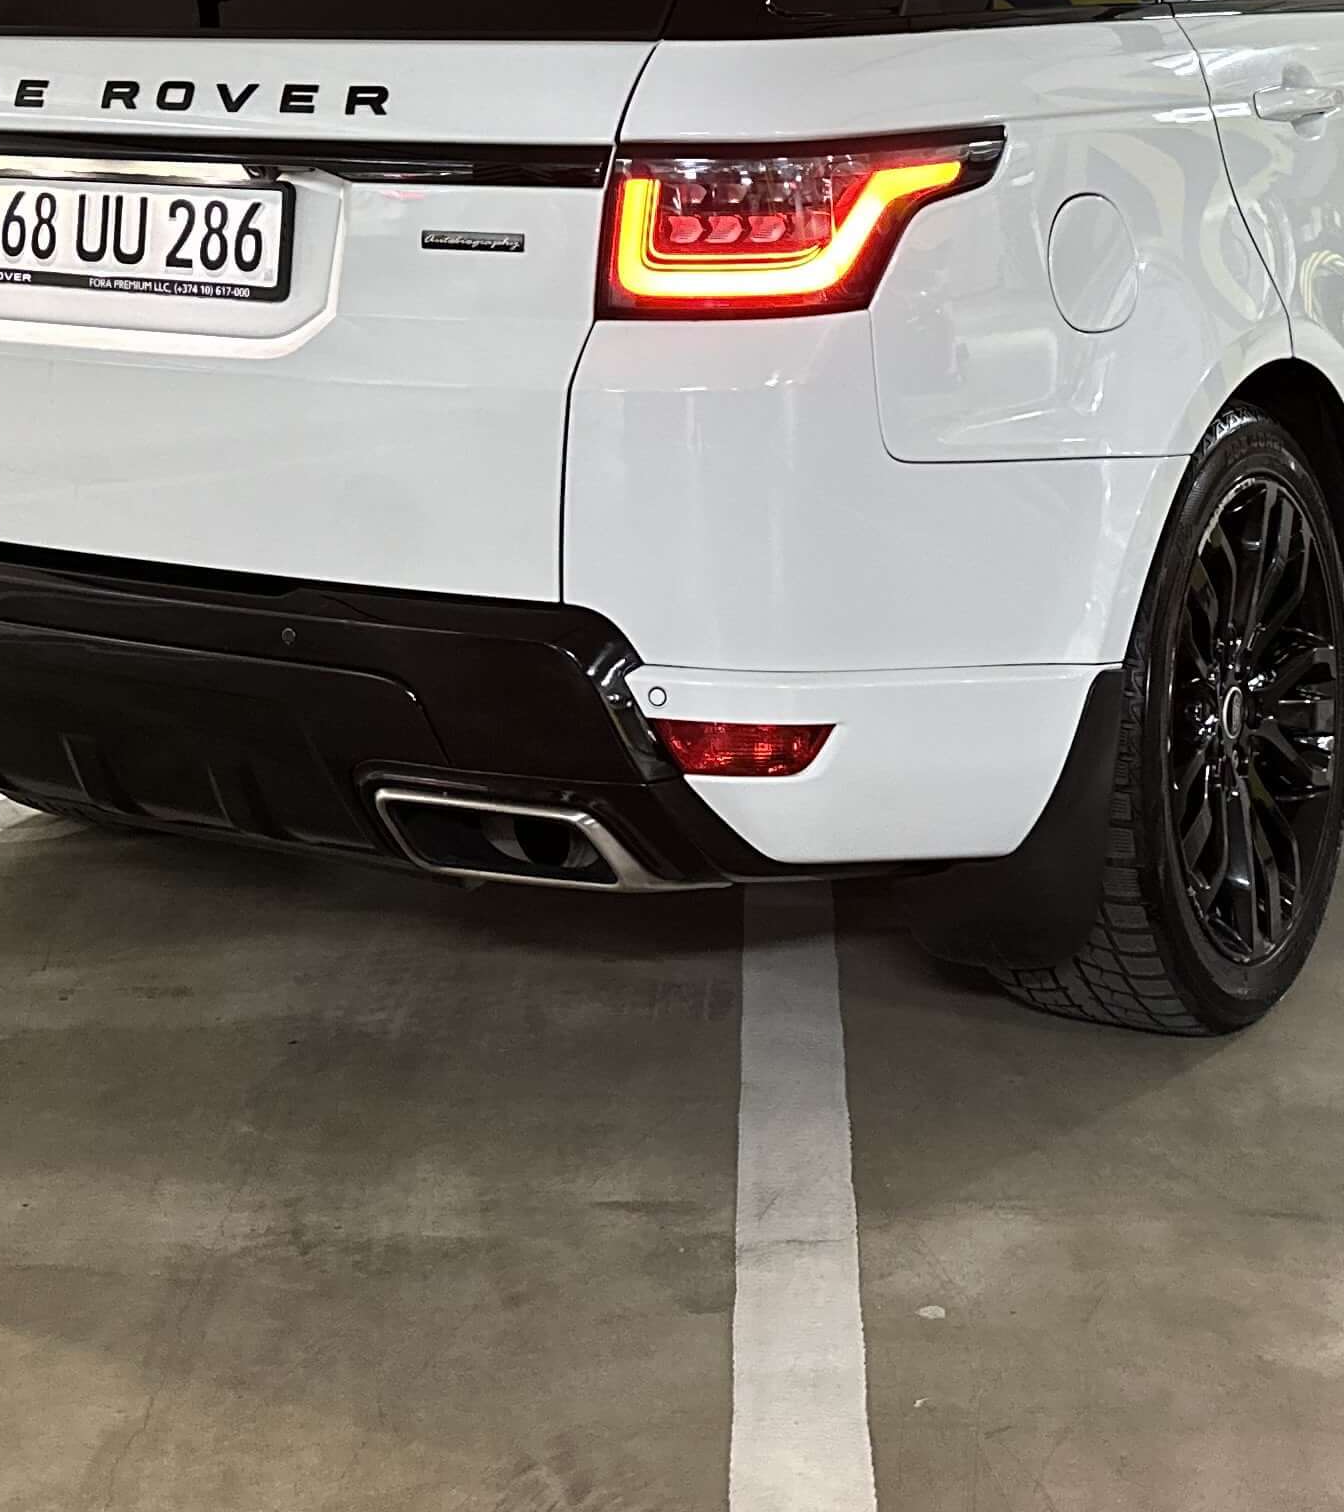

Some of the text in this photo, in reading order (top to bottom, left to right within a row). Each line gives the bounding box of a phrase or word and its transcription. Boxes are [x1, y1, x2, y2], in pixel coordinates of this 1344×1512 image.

[101, 79, 390, 116] ROVER
[1, 190, 265, 273] 68 UU 286
[89, 277, 112, 288] FORA
[113, 279, 153, 291] PREMIUM
[200, 285, 214, 297] 10)
[215, 287, 251, 298] 617-000
